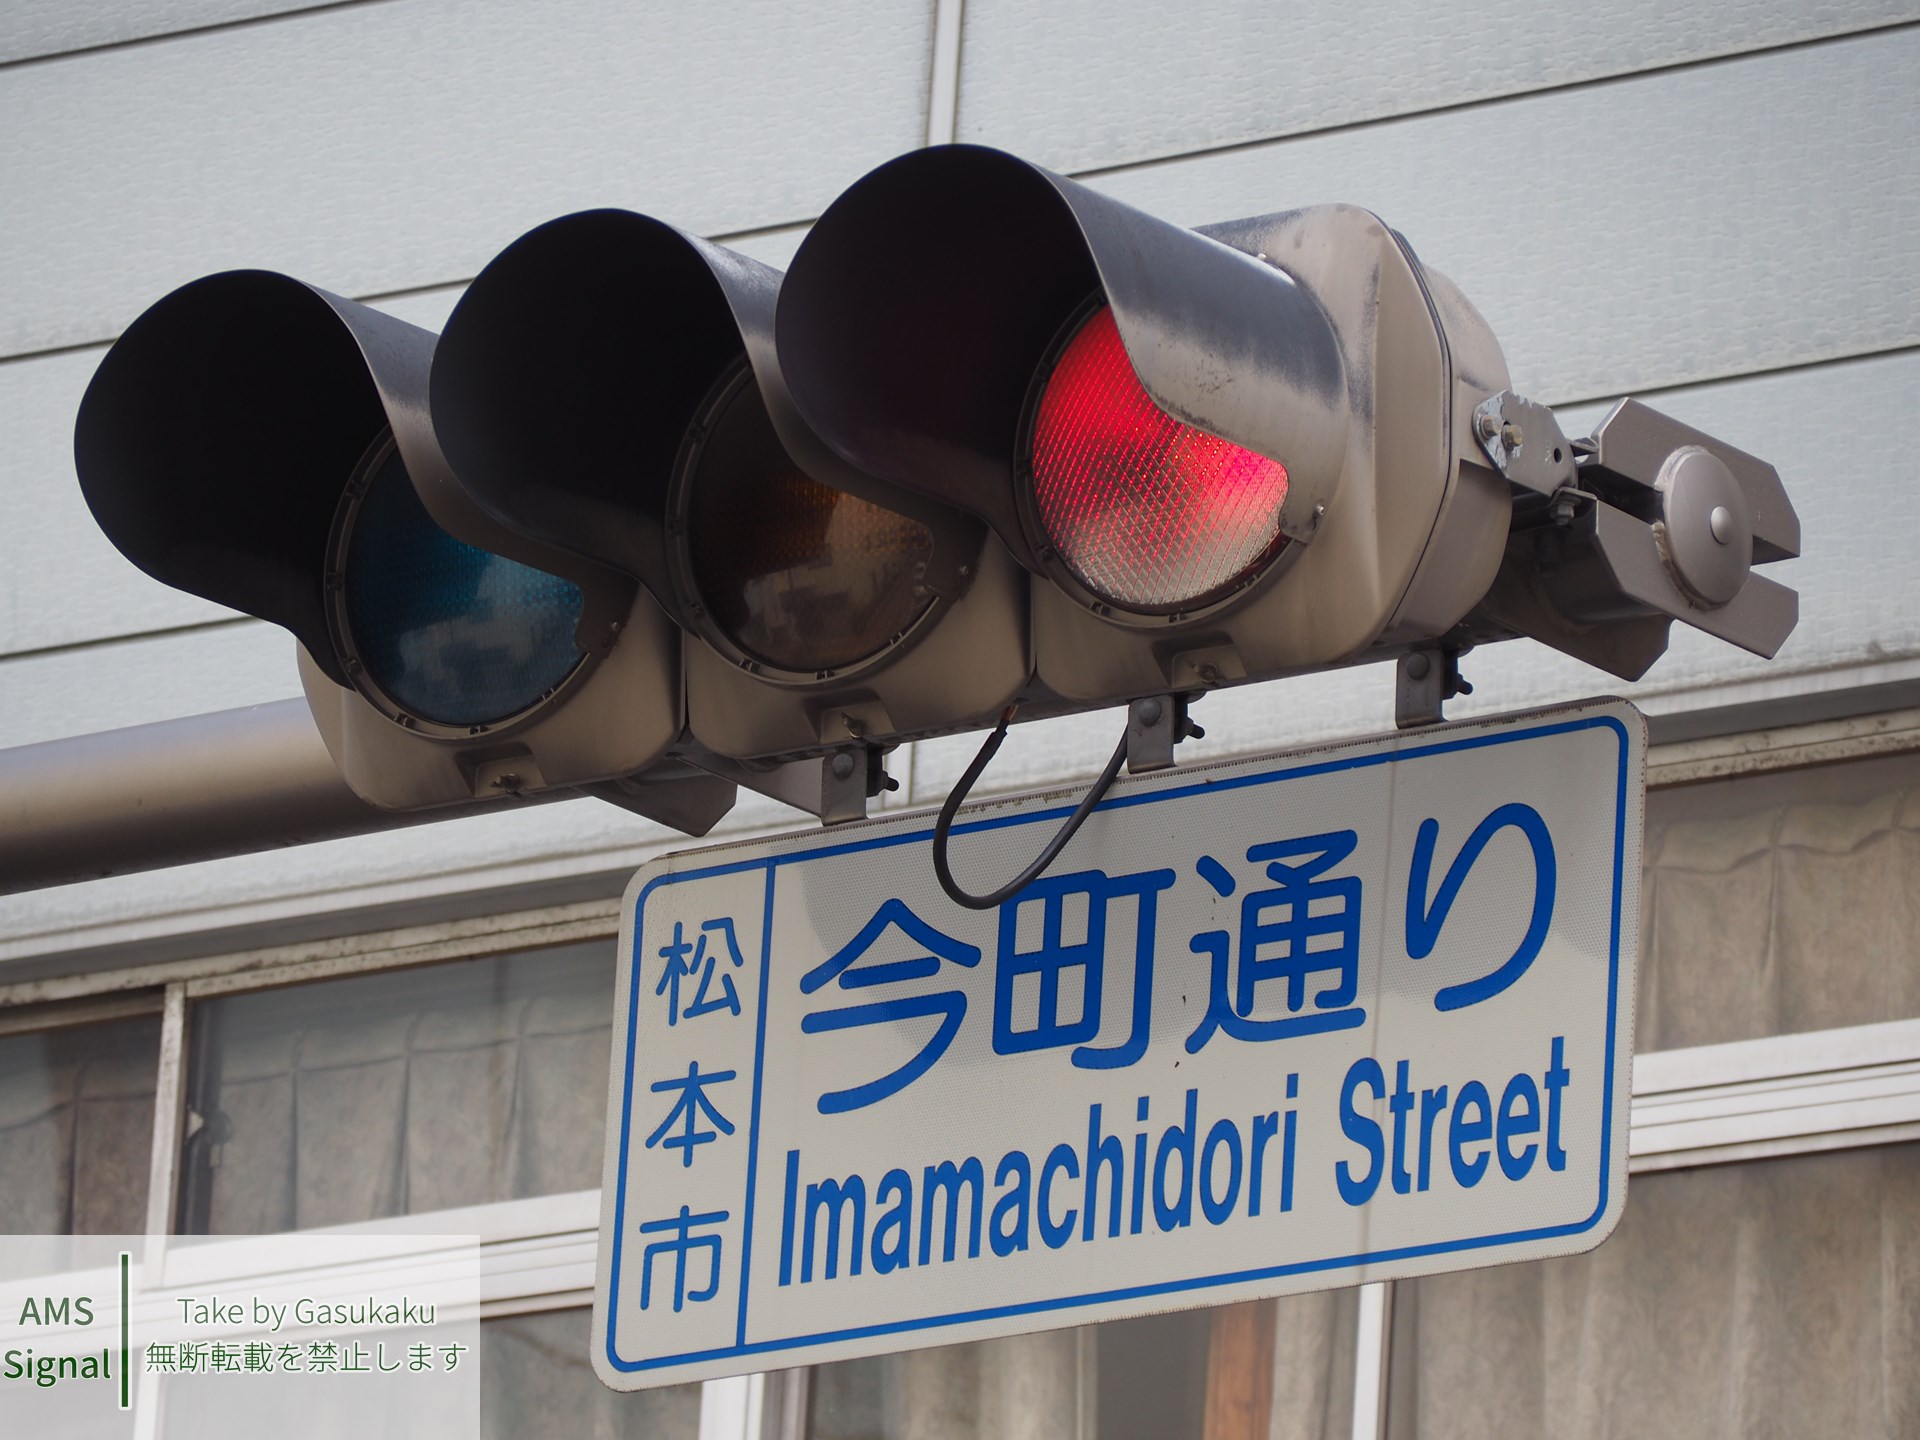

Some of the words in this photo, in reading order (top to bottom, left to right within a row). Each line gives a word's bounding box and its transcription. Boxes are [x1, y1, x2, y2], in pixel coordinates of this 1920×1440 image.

[639, 917, 744, 1313] 松本市
[799, 802, 1558, 1115] 今町通り
[777, 1073, 1299, 1287] Imamachidori
[1335, 1036, 1570, 1207] Street
